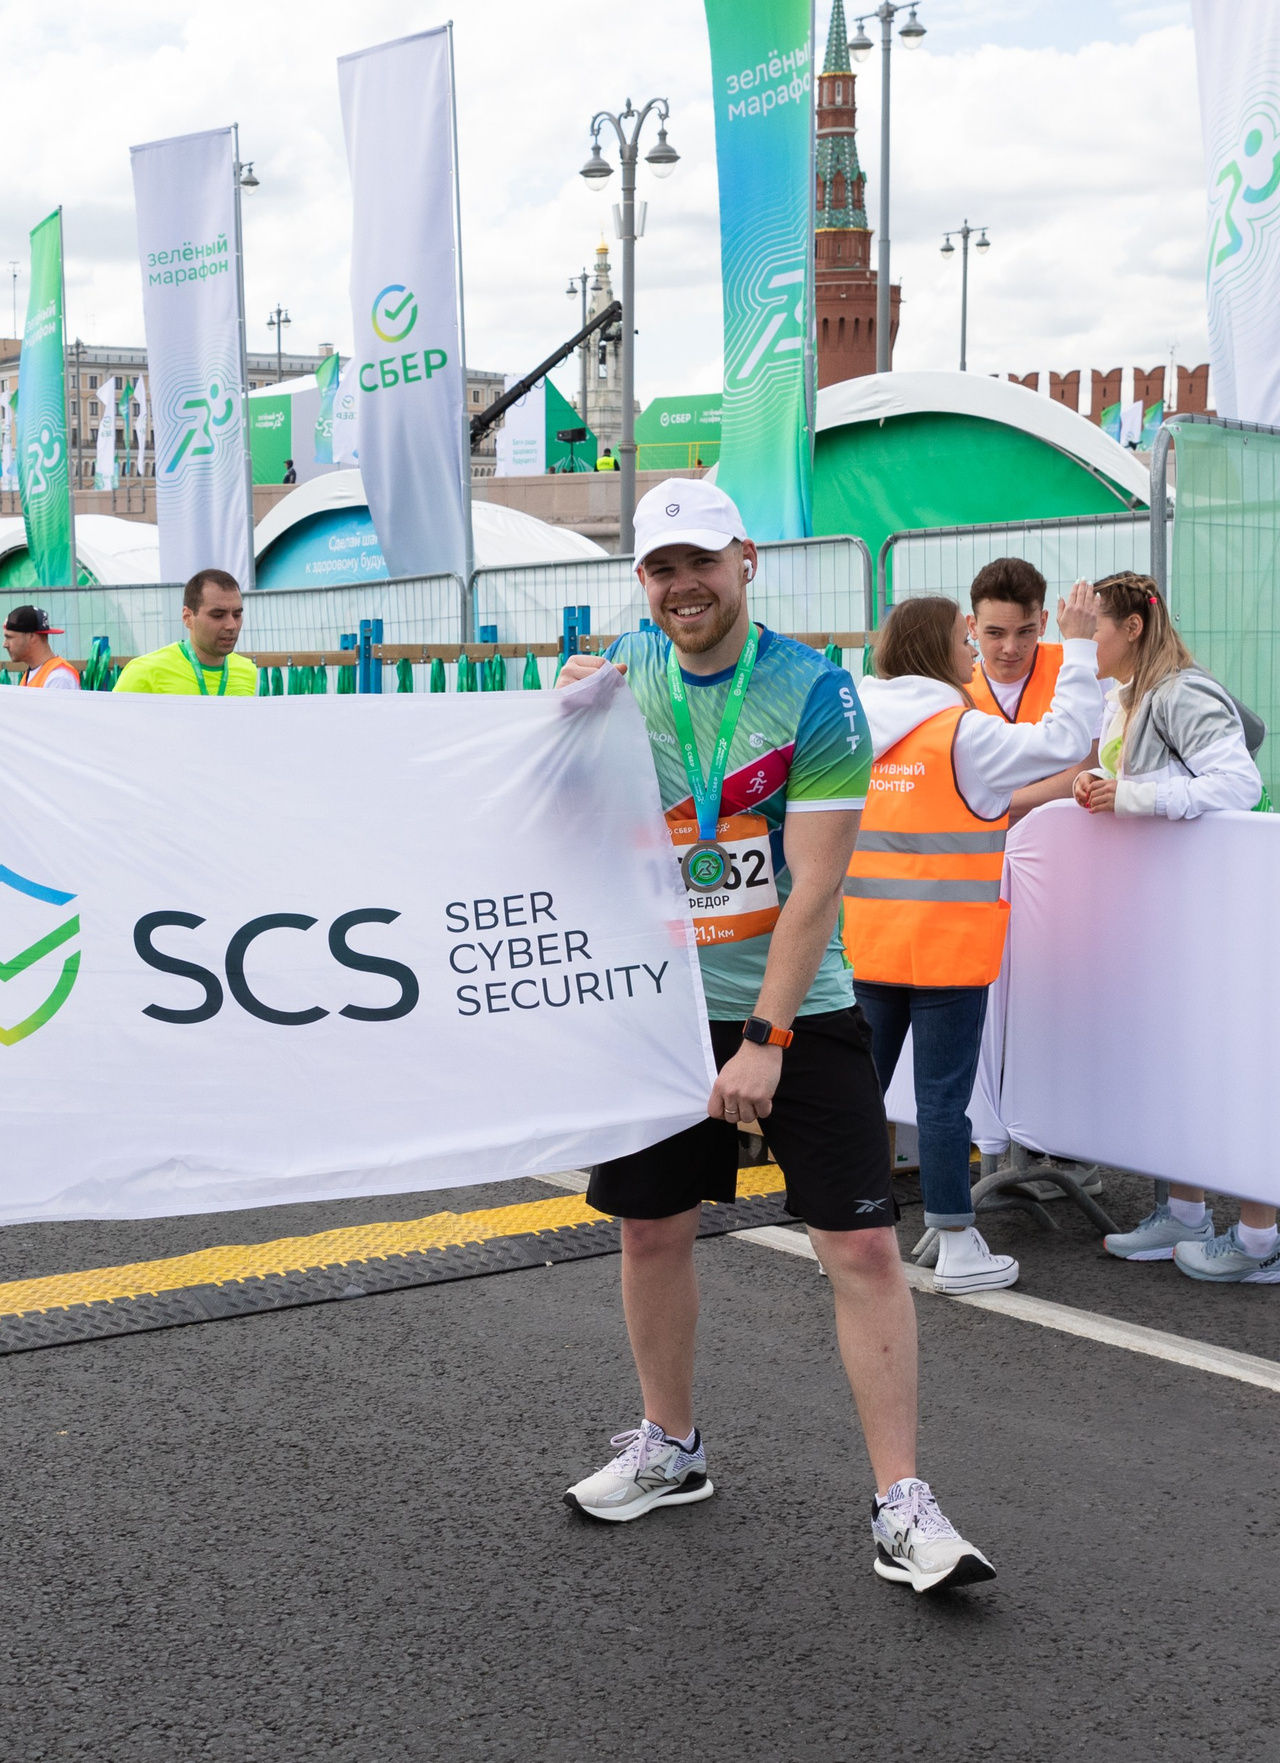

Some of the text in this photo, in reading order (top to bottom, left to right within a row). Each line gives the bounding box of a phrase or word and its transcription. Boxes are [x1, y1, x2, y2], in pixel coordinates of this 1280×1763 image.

[728, 71, 810, 122] марафо
[147, 233, 228, 267] зелёный
[148, 259, 228, 287] марафон
[359, 349, 448, 393] СБЕР
[670, 413, 691, 424] СБЕР
[328, 531, 361, 552] Сделай
[312, 557, 359, 575] здоровому
[361, 551, 387, 571] буду
[868, 779, 915, 792] ЛОНТЁР
[872, 762, 926, 776] ТИВНЫЙ
[445, 891, 557, 934] SBER
[132, 907, 420, 1026] SCS
[448, 929, 592, 976] CYBER
[456, 960, 669, 1016] SECURITY
